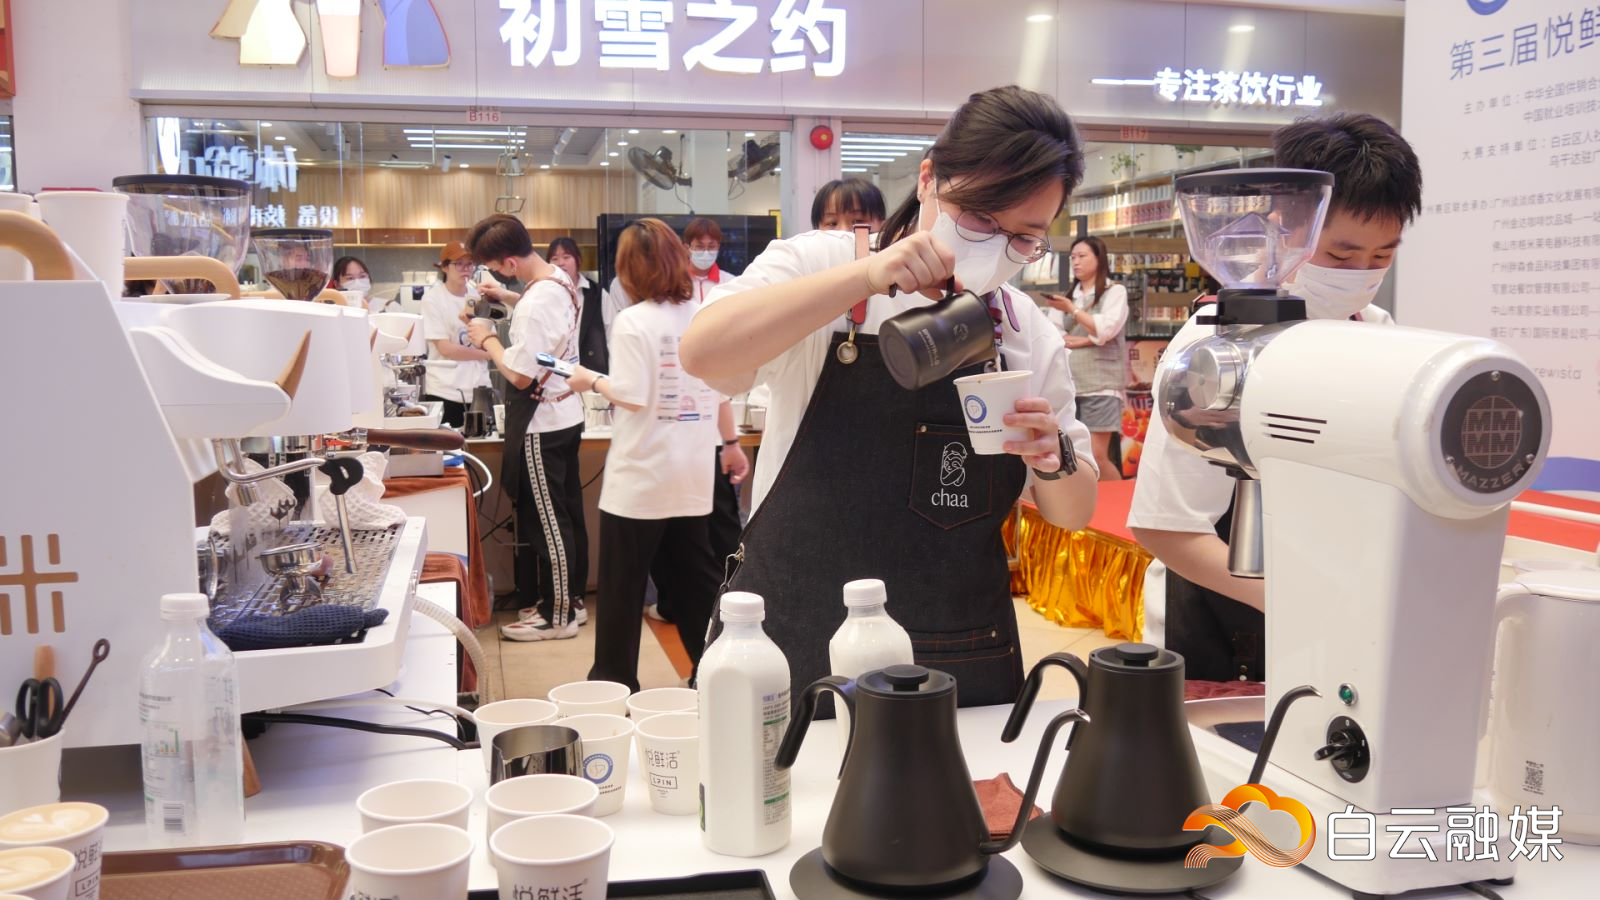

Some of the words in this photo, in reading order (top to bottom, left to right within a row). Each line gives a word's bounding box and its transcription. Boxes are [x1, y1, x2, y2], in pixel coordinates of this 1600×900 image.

[499, 0, 847, 77] 初雪之约
[469, 111, 500, 122] B116
[1534, 366, 1583, 380] rewista
[1456, 464, 1526, 489] MAZZER
[931, 488, 969, 508] chaa
